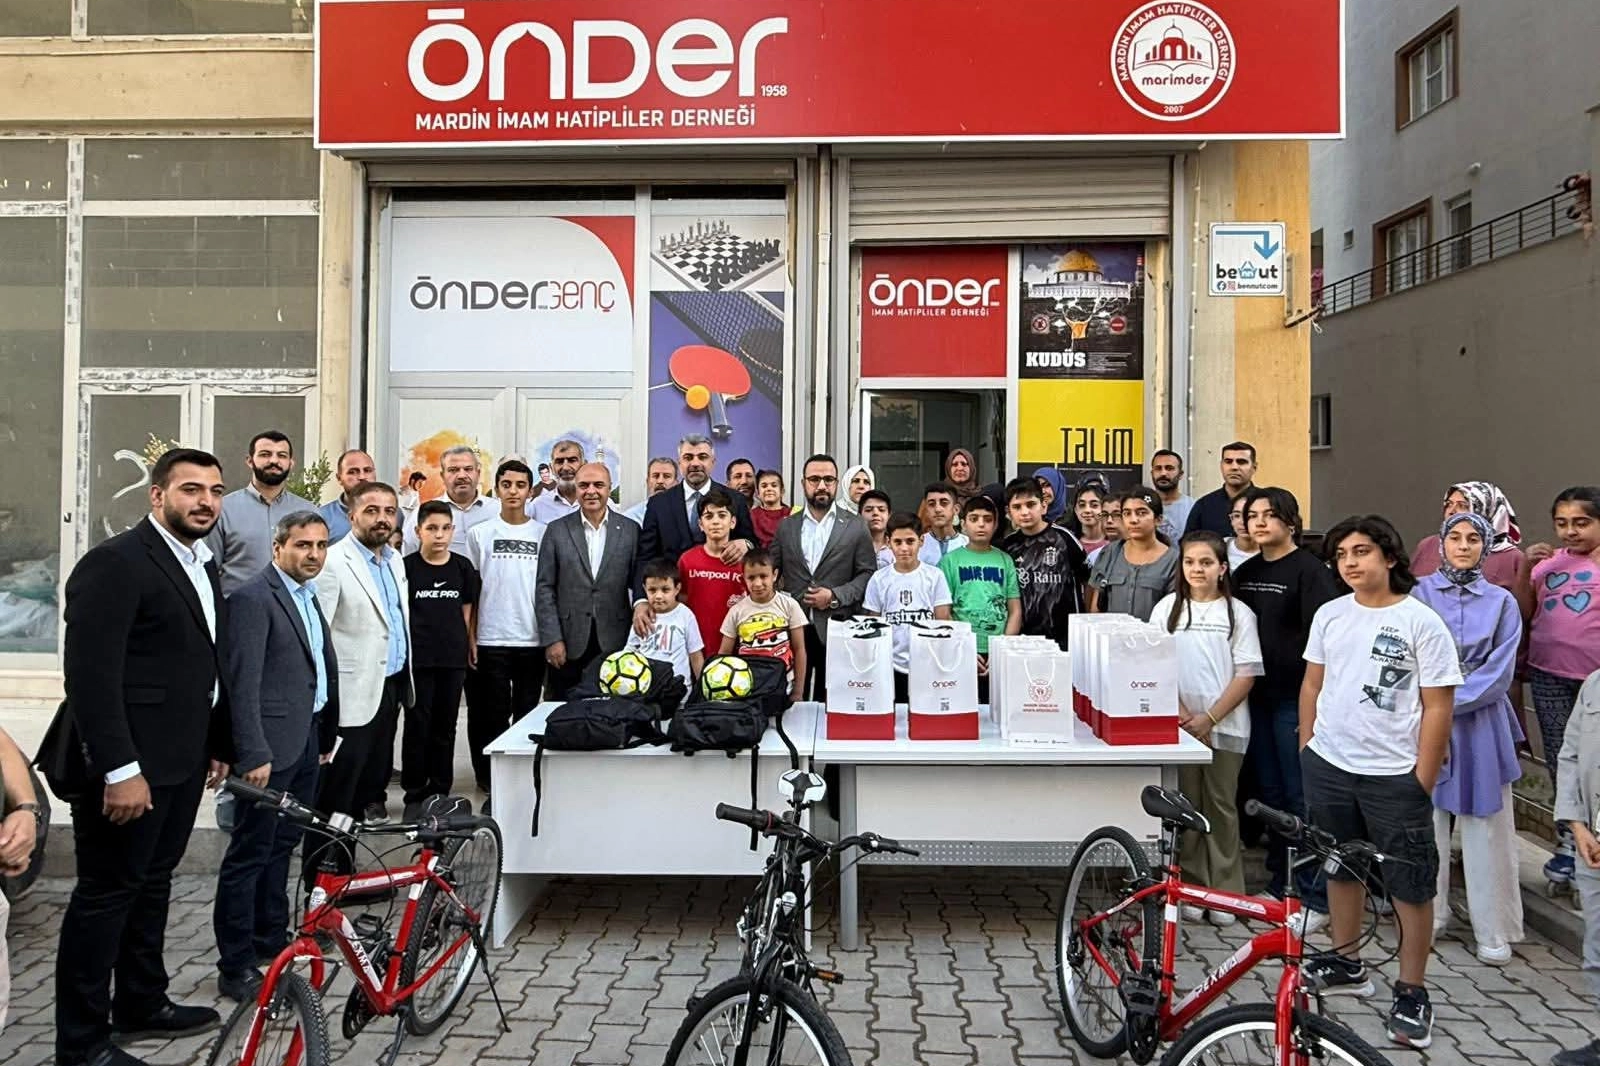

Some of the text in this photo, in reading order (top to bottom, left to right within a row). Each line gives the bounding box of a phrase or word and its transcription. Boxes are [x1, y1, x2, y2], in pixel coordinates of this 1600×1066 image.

[1142, 73, 1210, 86] marimder
[760, 85, 787, 97] 1958
[1163, 105, 1184, 114] 2007
[415, 104, 756, 130] MARDİN İMAM HATİPLİLER DERNEĞİ
[1025, 348, 1086, 367] KUDÜS
[689, 569, 730, 580] Liverpool
[1033, 571, 1062, 584] Rain
[415, 591, 438, 599] NIKE
